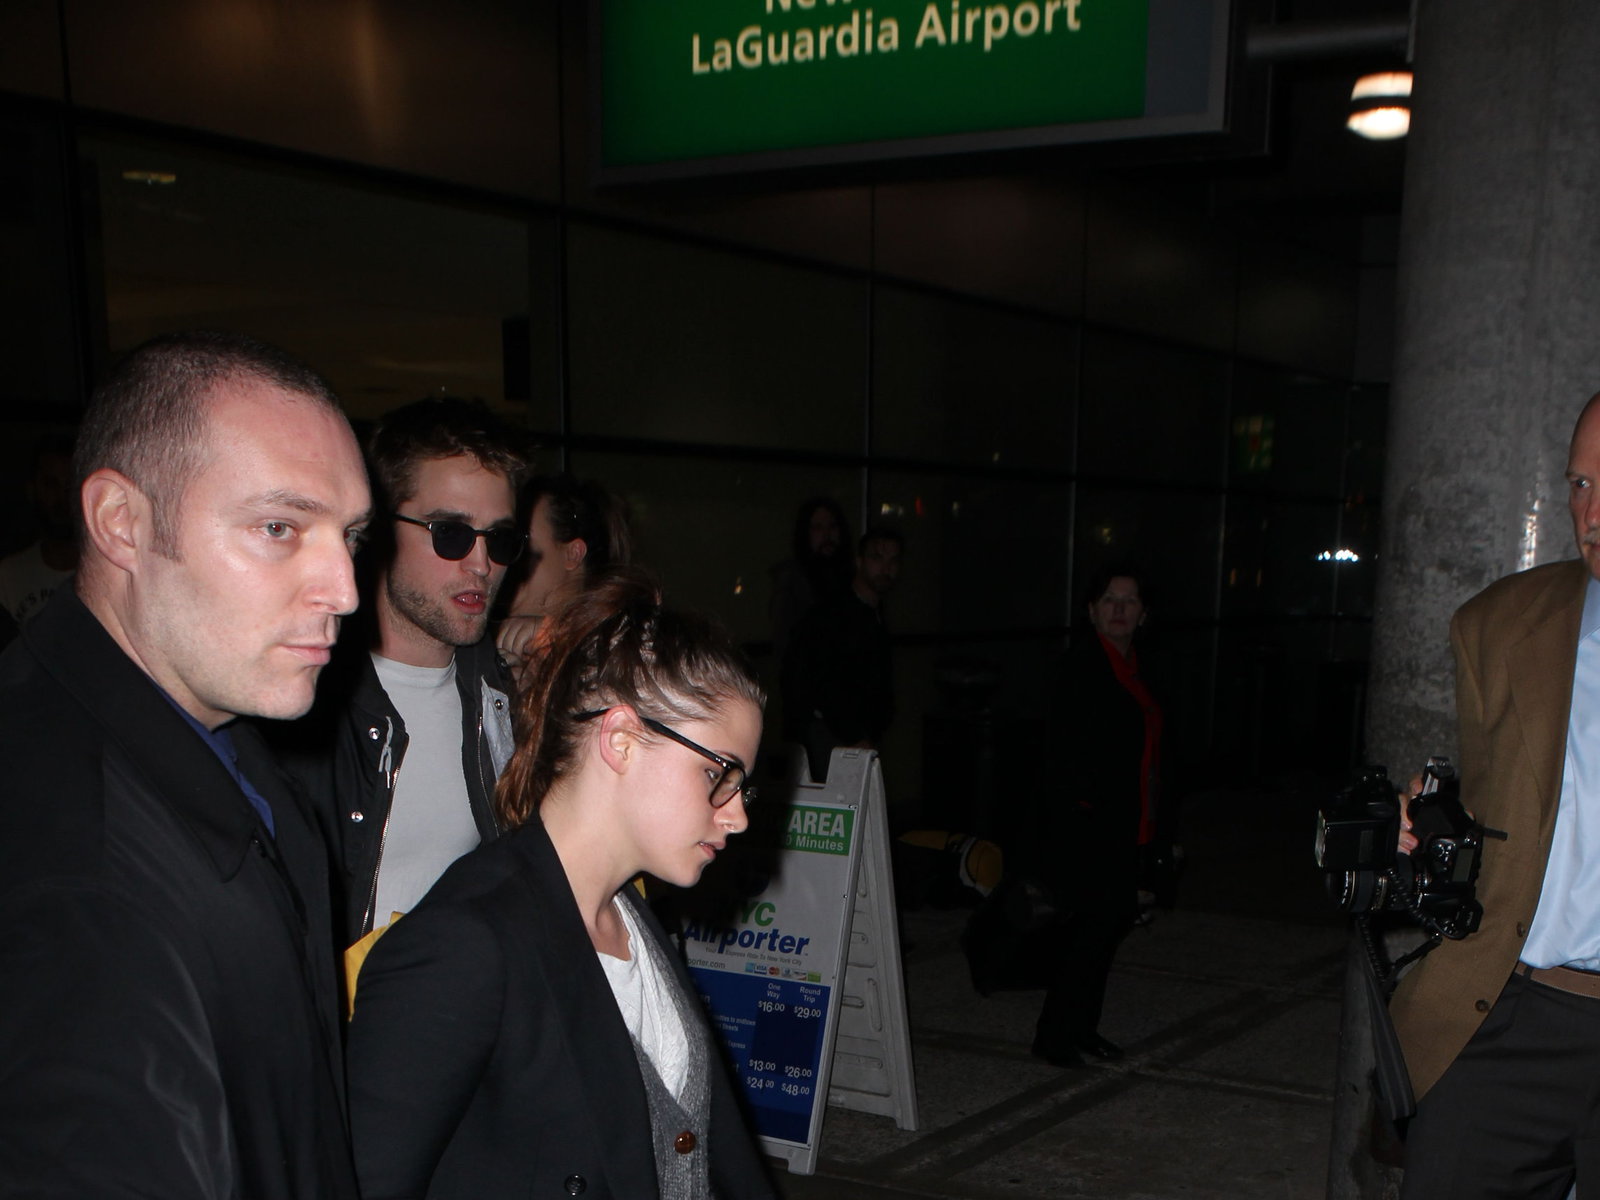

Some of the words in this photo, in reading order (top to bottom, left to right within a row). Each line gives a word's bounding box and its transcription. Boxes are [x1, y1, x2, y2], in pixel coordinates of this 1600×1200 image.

[692, 8, 899, 75] LaGuardia
[914, 0, 1082, 52] Airport
[787, 809, 845, 838] AREA
[795, 835, 845, 852] Minutes
[740, 902, 776, 927] YC
[687, 959, 726, 969] porter.com
[768, 982, 781, 991] One
[800, 986, 821, 996] Round
[767, 990, 780, 1000] Way
[803, 995, 816, 1004] Trip
[758, 1000, 785, 1013] $16.00
[794, 1005, 821, 1019] $29.00
[749, 1059, 776, 1071] $13.00
[785, 1065, 812, 1078] $26.00
[781, 1083, 810, 1096] $48.00
